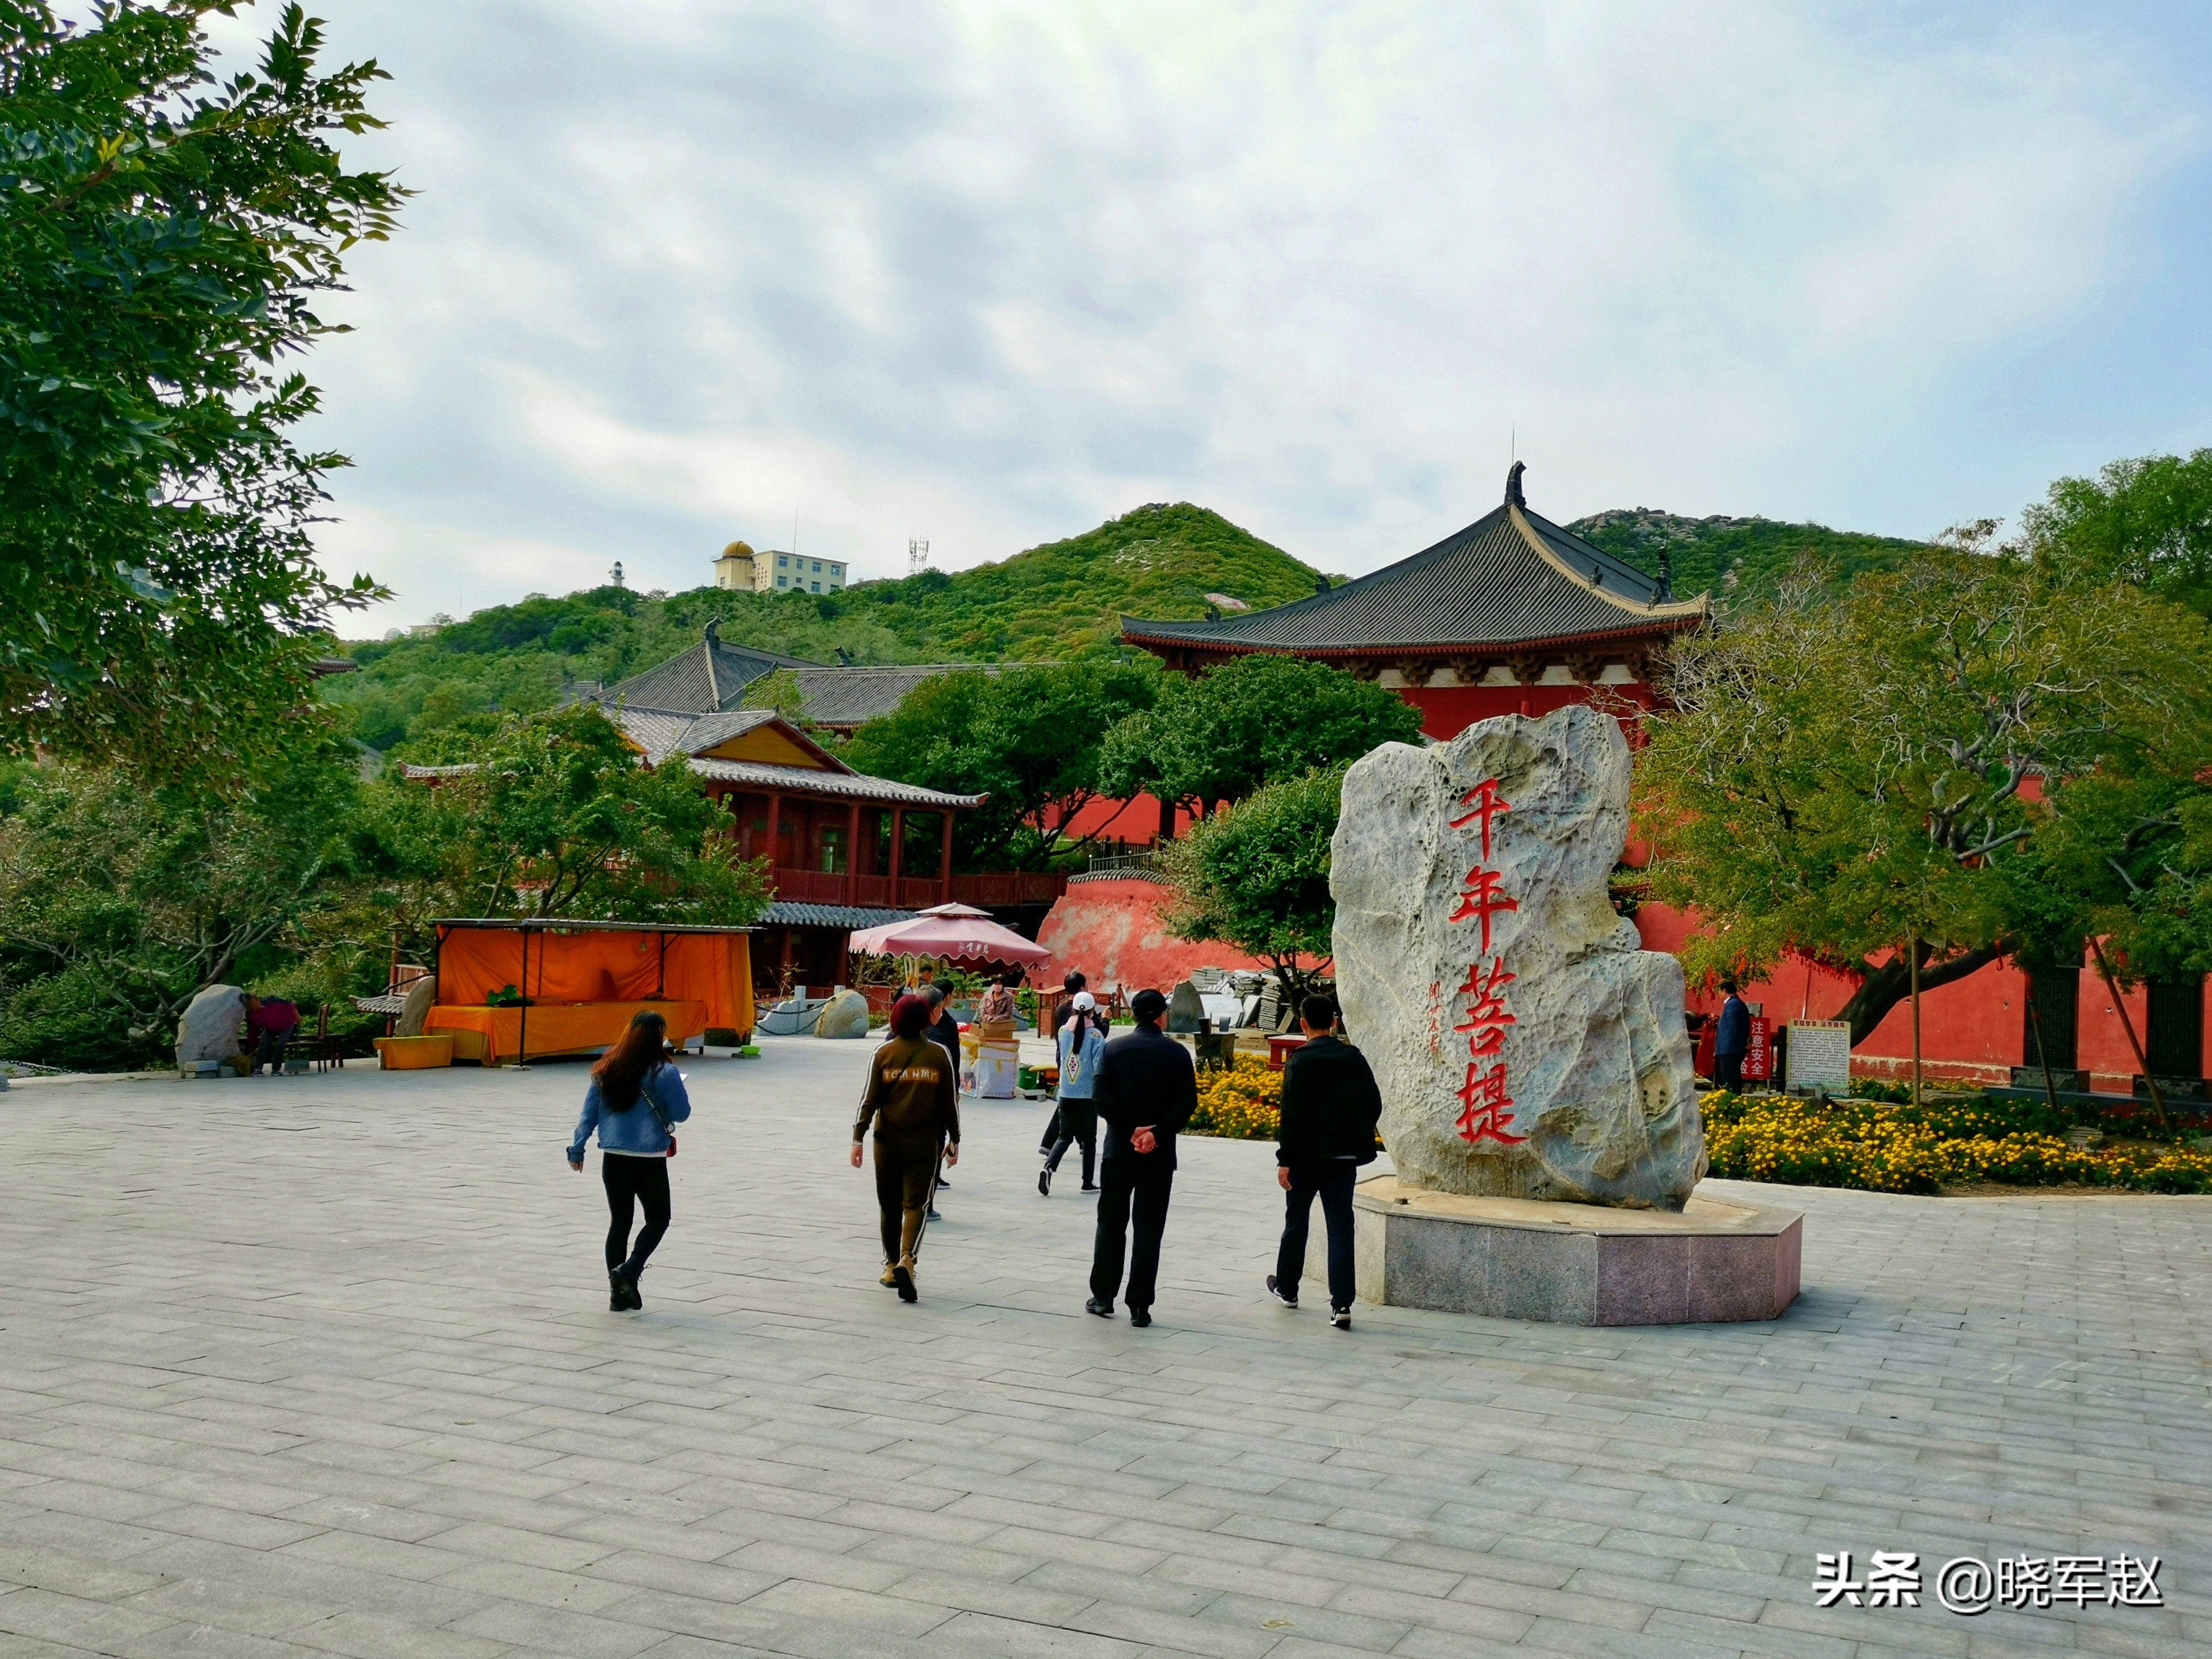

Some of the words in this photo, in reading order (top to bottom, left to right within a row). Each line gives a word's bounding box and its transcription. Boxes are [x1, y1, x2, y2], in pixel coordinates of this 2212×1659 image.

[1449, 778, 1529, 1145] 千年菩提
[1751, 1021, 1764, 1075] 注意安全
